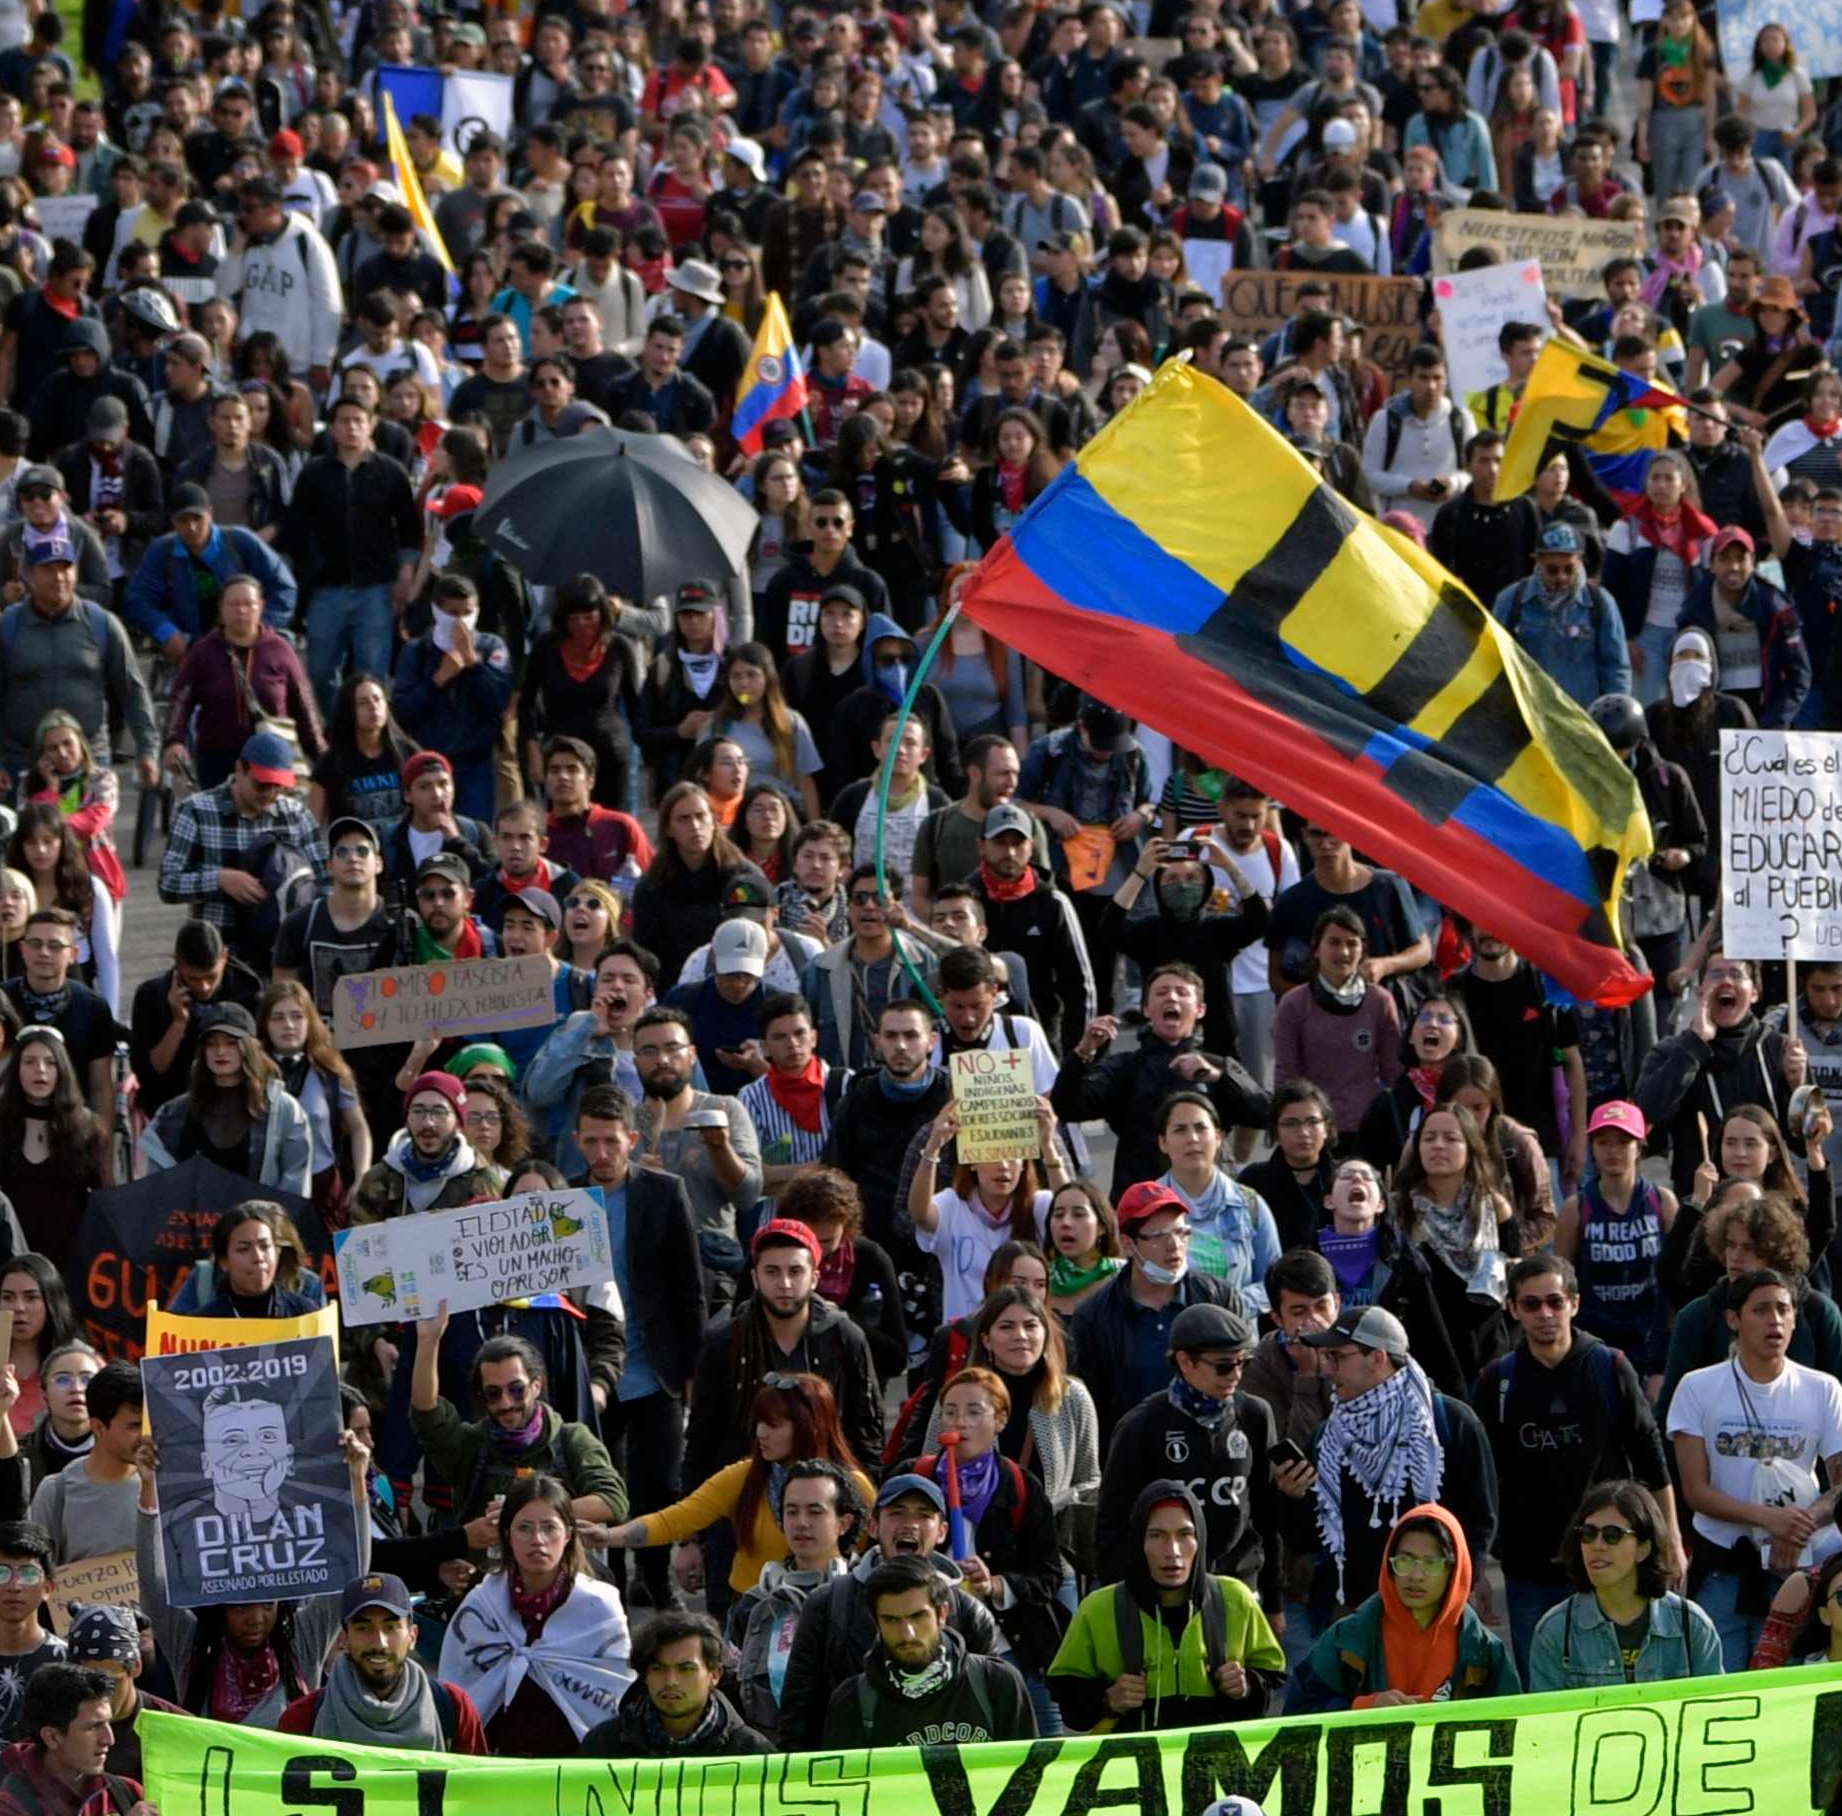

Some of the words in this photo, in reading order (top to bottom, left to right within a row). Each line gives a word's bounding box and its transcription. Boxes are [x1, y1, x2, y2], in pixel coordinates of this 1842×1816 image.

[1459, 220, 1572, 246] NUESTROS
[1507, 245, 1535, 262] NO
[246, 264, 294, 297] GAP
[1793, 759, 1817, 776] es
[1824, 750, 1840, 773] el
[1731, 786, 1816, 823] MIEDO
[1733, 878, 1750, 909] al
[957, 1052, 996, 1075] NO
[471, 1225, 552, 1258] VIOLADOR
[1590, 1243, 1637, 1262] GOOD
[499, 1254, 522, 1276] UN
[527, 1246, 576, 1269] MACHO
[194, 1502, 325, 1548] DILAN
[199, 1537, 327, 1578] CRUZ
[200, 1575, 256, 1595] ASESINADO
[257, 1573, 277, 1588] POR
[288, 1567, 328, 1586] ESTADO
[557, 1750, 871, 1816] NOS
[919, 1720, 1517, 1816] VAMOS
[1571, 1696, 1760, 1816] DE
